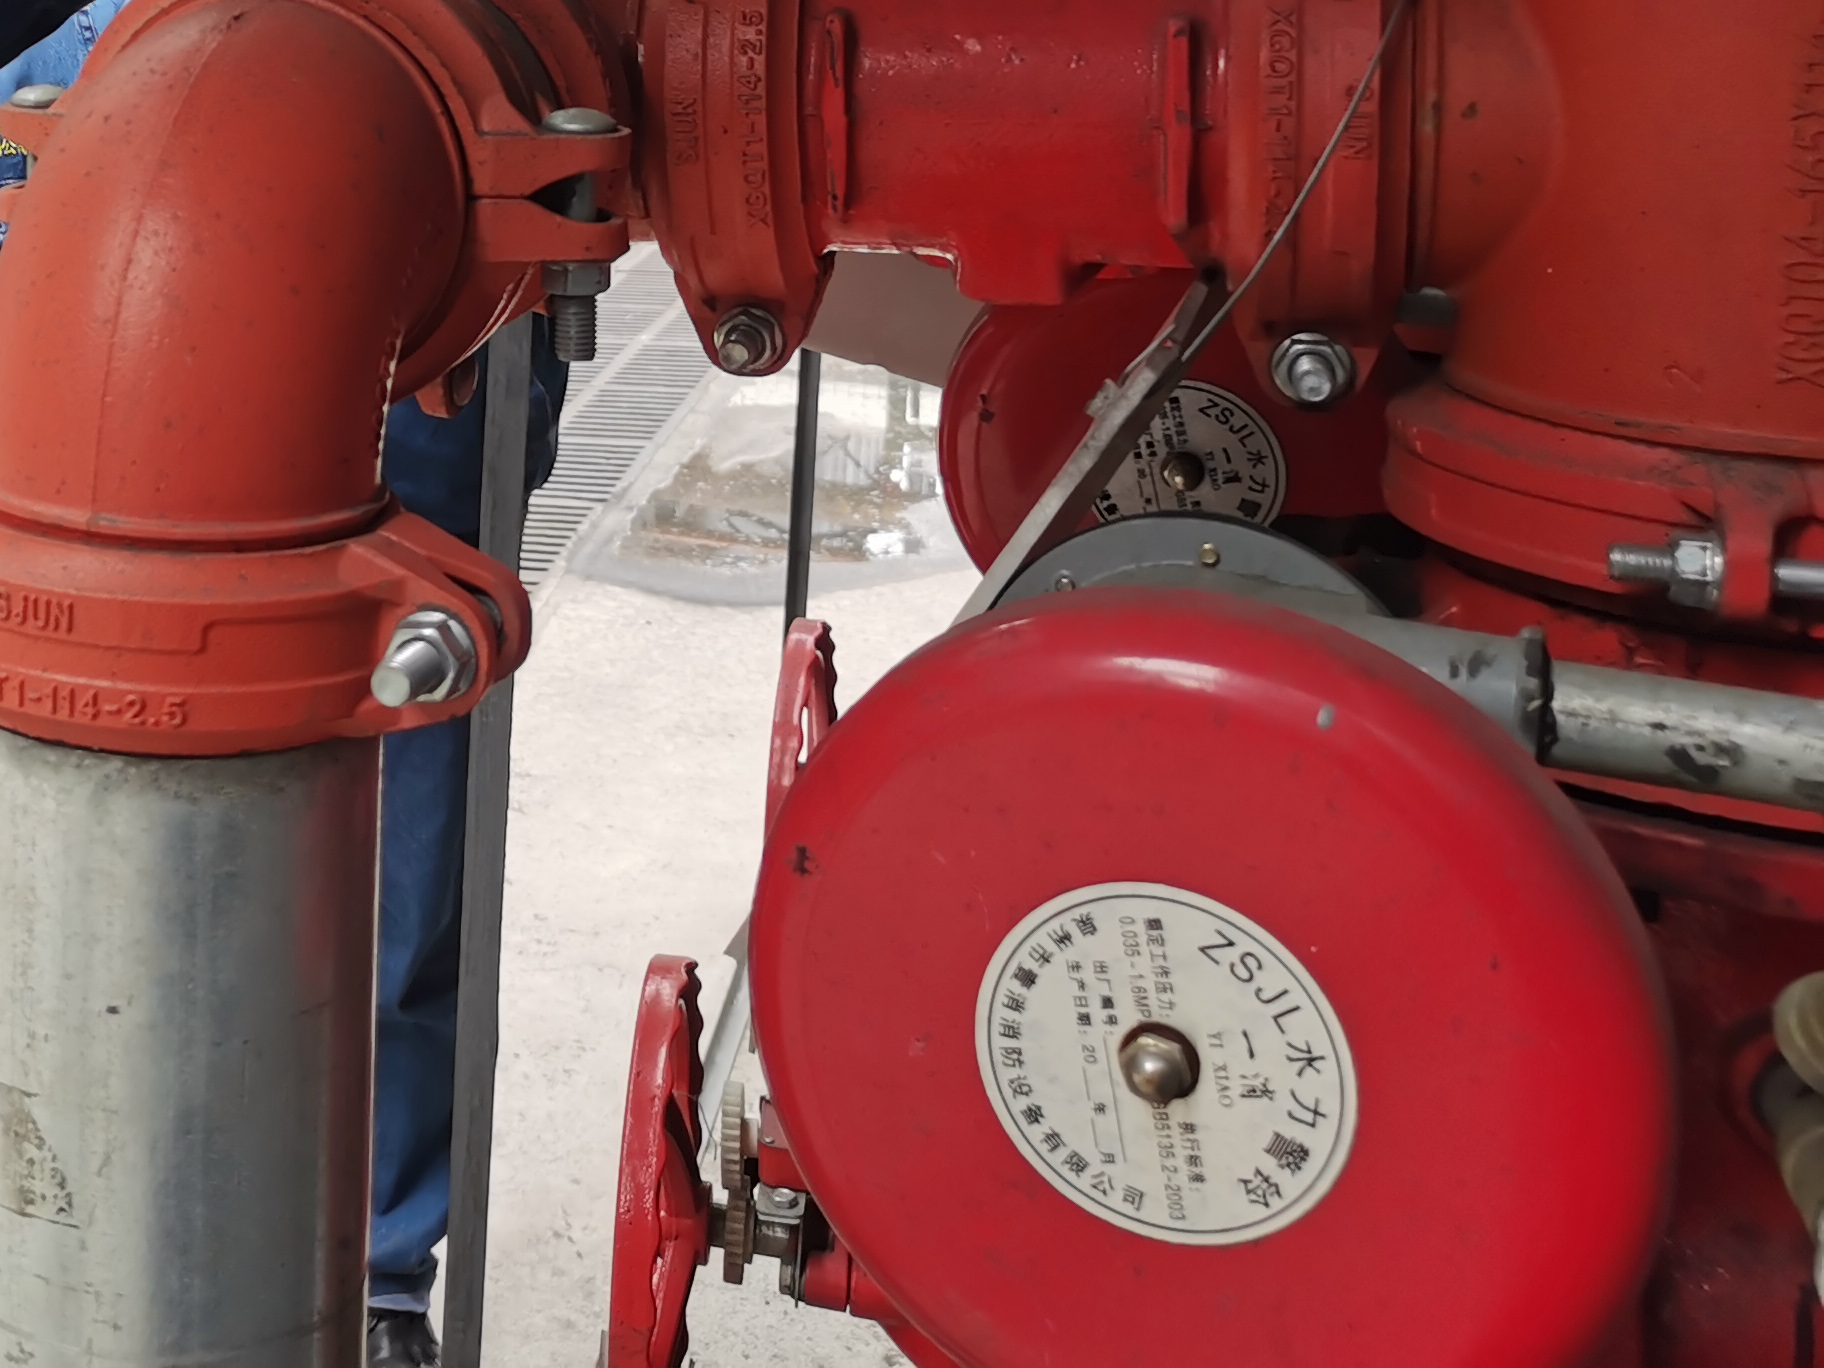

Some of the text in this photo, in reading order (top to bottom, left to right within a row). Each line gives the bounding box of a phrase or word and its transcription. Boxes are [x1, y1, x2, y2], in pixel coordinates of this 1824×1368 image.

[737, 9, 771, 229] XGQT1-114-2.5
[1197, 928, 1328, 1209] ZSJL水力警铃
[1207, 1031, 1235, 1109] YI XIAO
[1238, 1029, 1275, 1102] 一消
